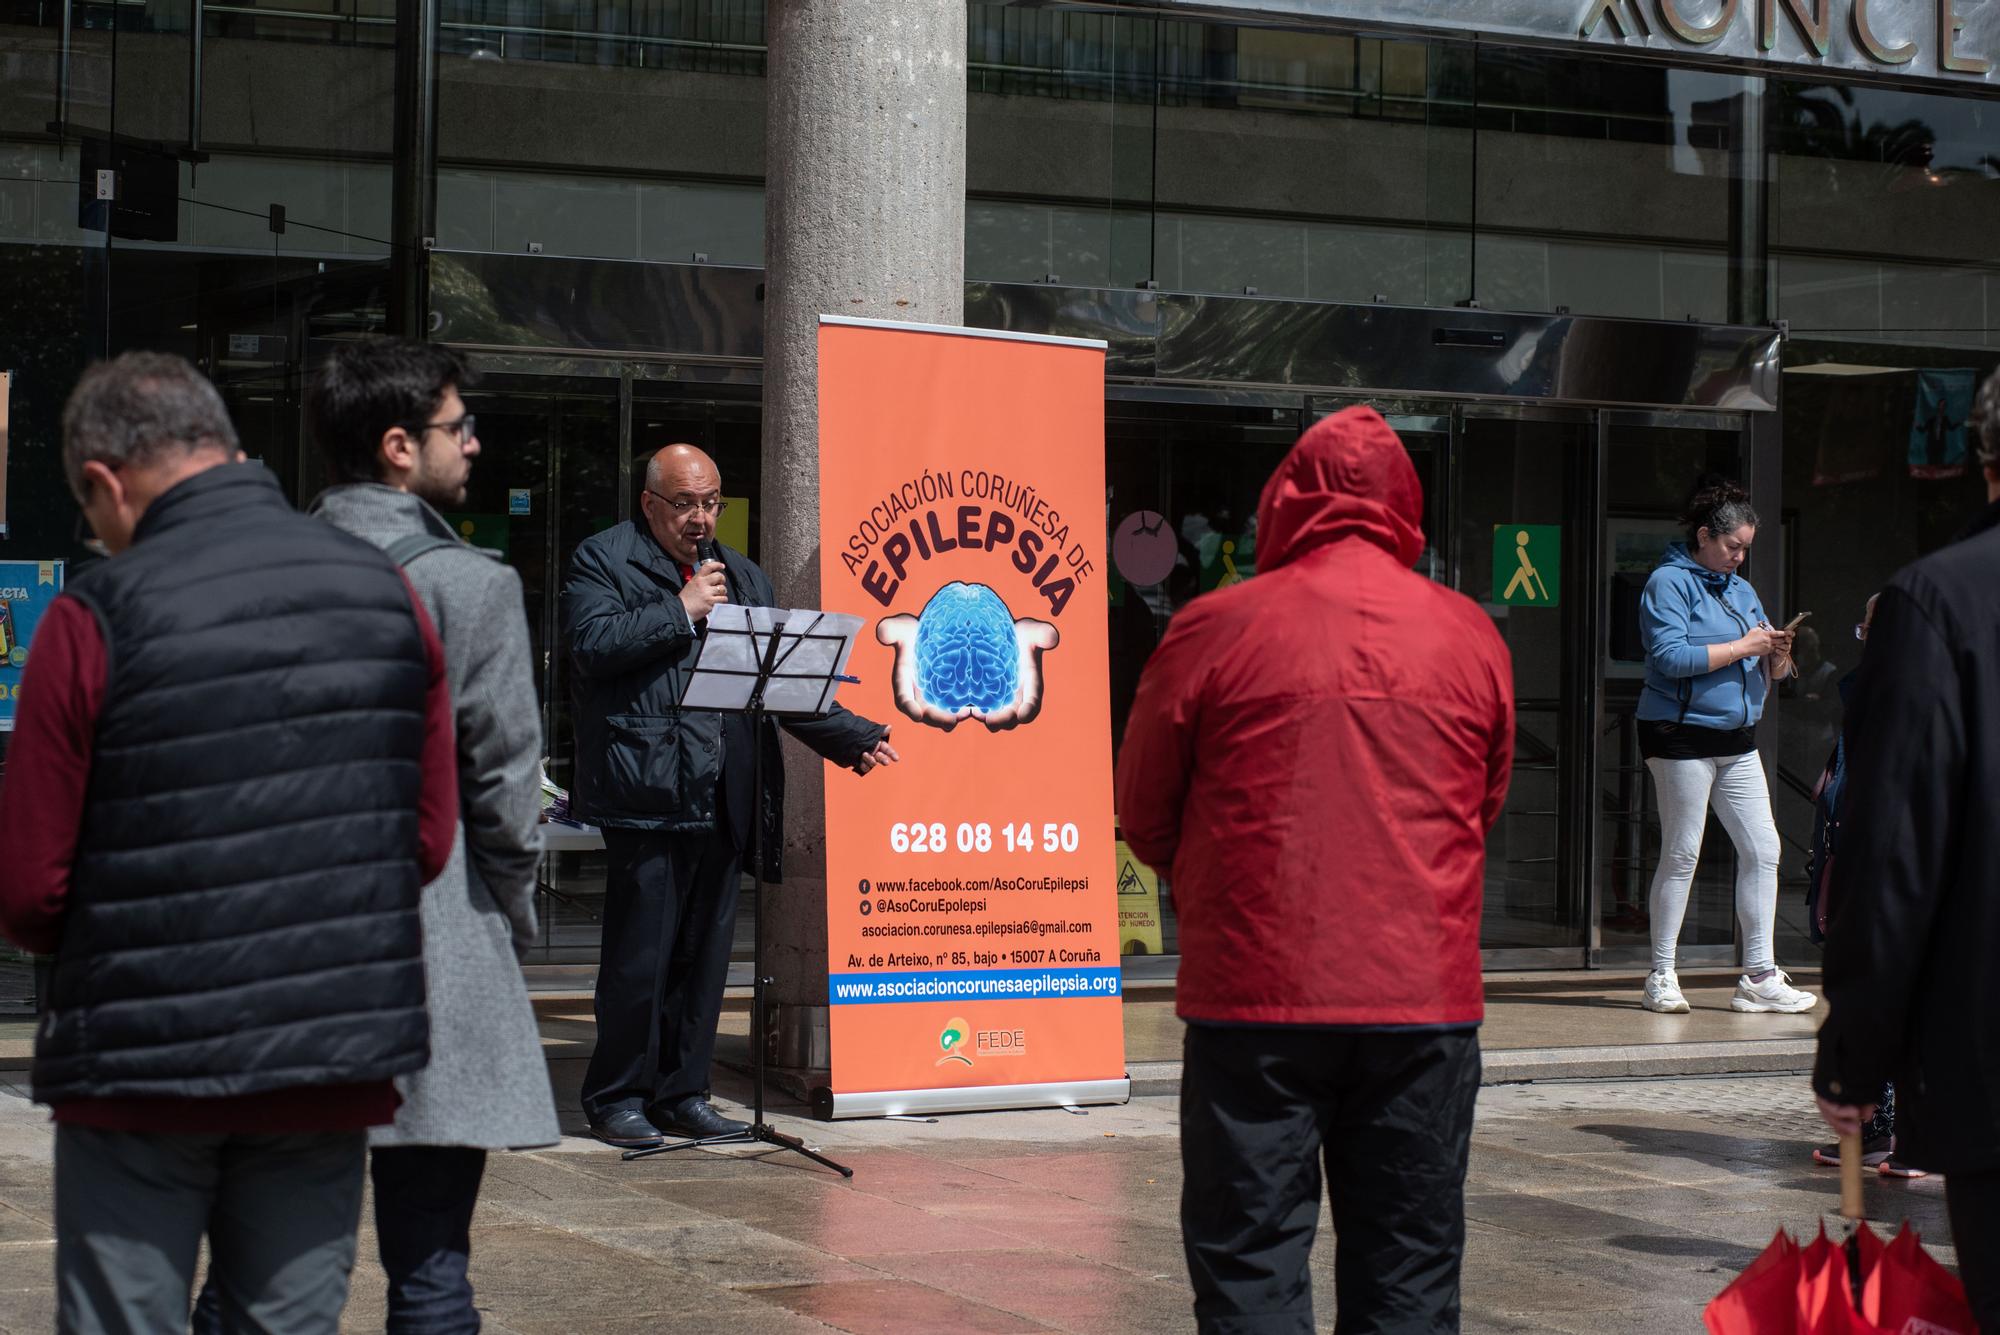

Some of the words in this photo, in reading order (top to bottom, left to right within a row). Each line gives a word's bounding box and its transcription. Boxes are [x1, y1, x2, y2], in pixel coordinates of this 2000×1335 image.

[841, 468, 954, 577] ASOCIACIÓN
[960, 470, 1069, 551] CORUÑESA
[1065, 543, 1095, 585] DE
[861, 505, 1075, 617] EPILEPSIA
[890, 822, 947, 853] 628
[956, 822, 992, 853] 08
[1002, 822, 1034, 853] 14
[1043, 822, 1079, 853] 50
[876, 877, 1089, 894] www.facebook.com/AsoCoruEpilepsi
[876, 898, 987, 915] @AsoCoruEpolepsi
[861, 920, 1092, 937] asociacion.corunesa.epilepsia6@gmail.com
[847, 953, 865, 967] Av.
[868, 953, 884, 967] de
[887, 952, 933, 968] Arteixo,
[951, 951, 970, 967] 85,
[973, 951, 998, 967] bajo
[1010, 950, 1045, 963] 15007
[1048, 949, 1057, 962] A
[1059, 948, 1101, 962] Coruña
[836, 973, 1117, 998] www.asociacioncorunesaepilepsia.org
[977, 1030, 1025, 1049] FEDE
